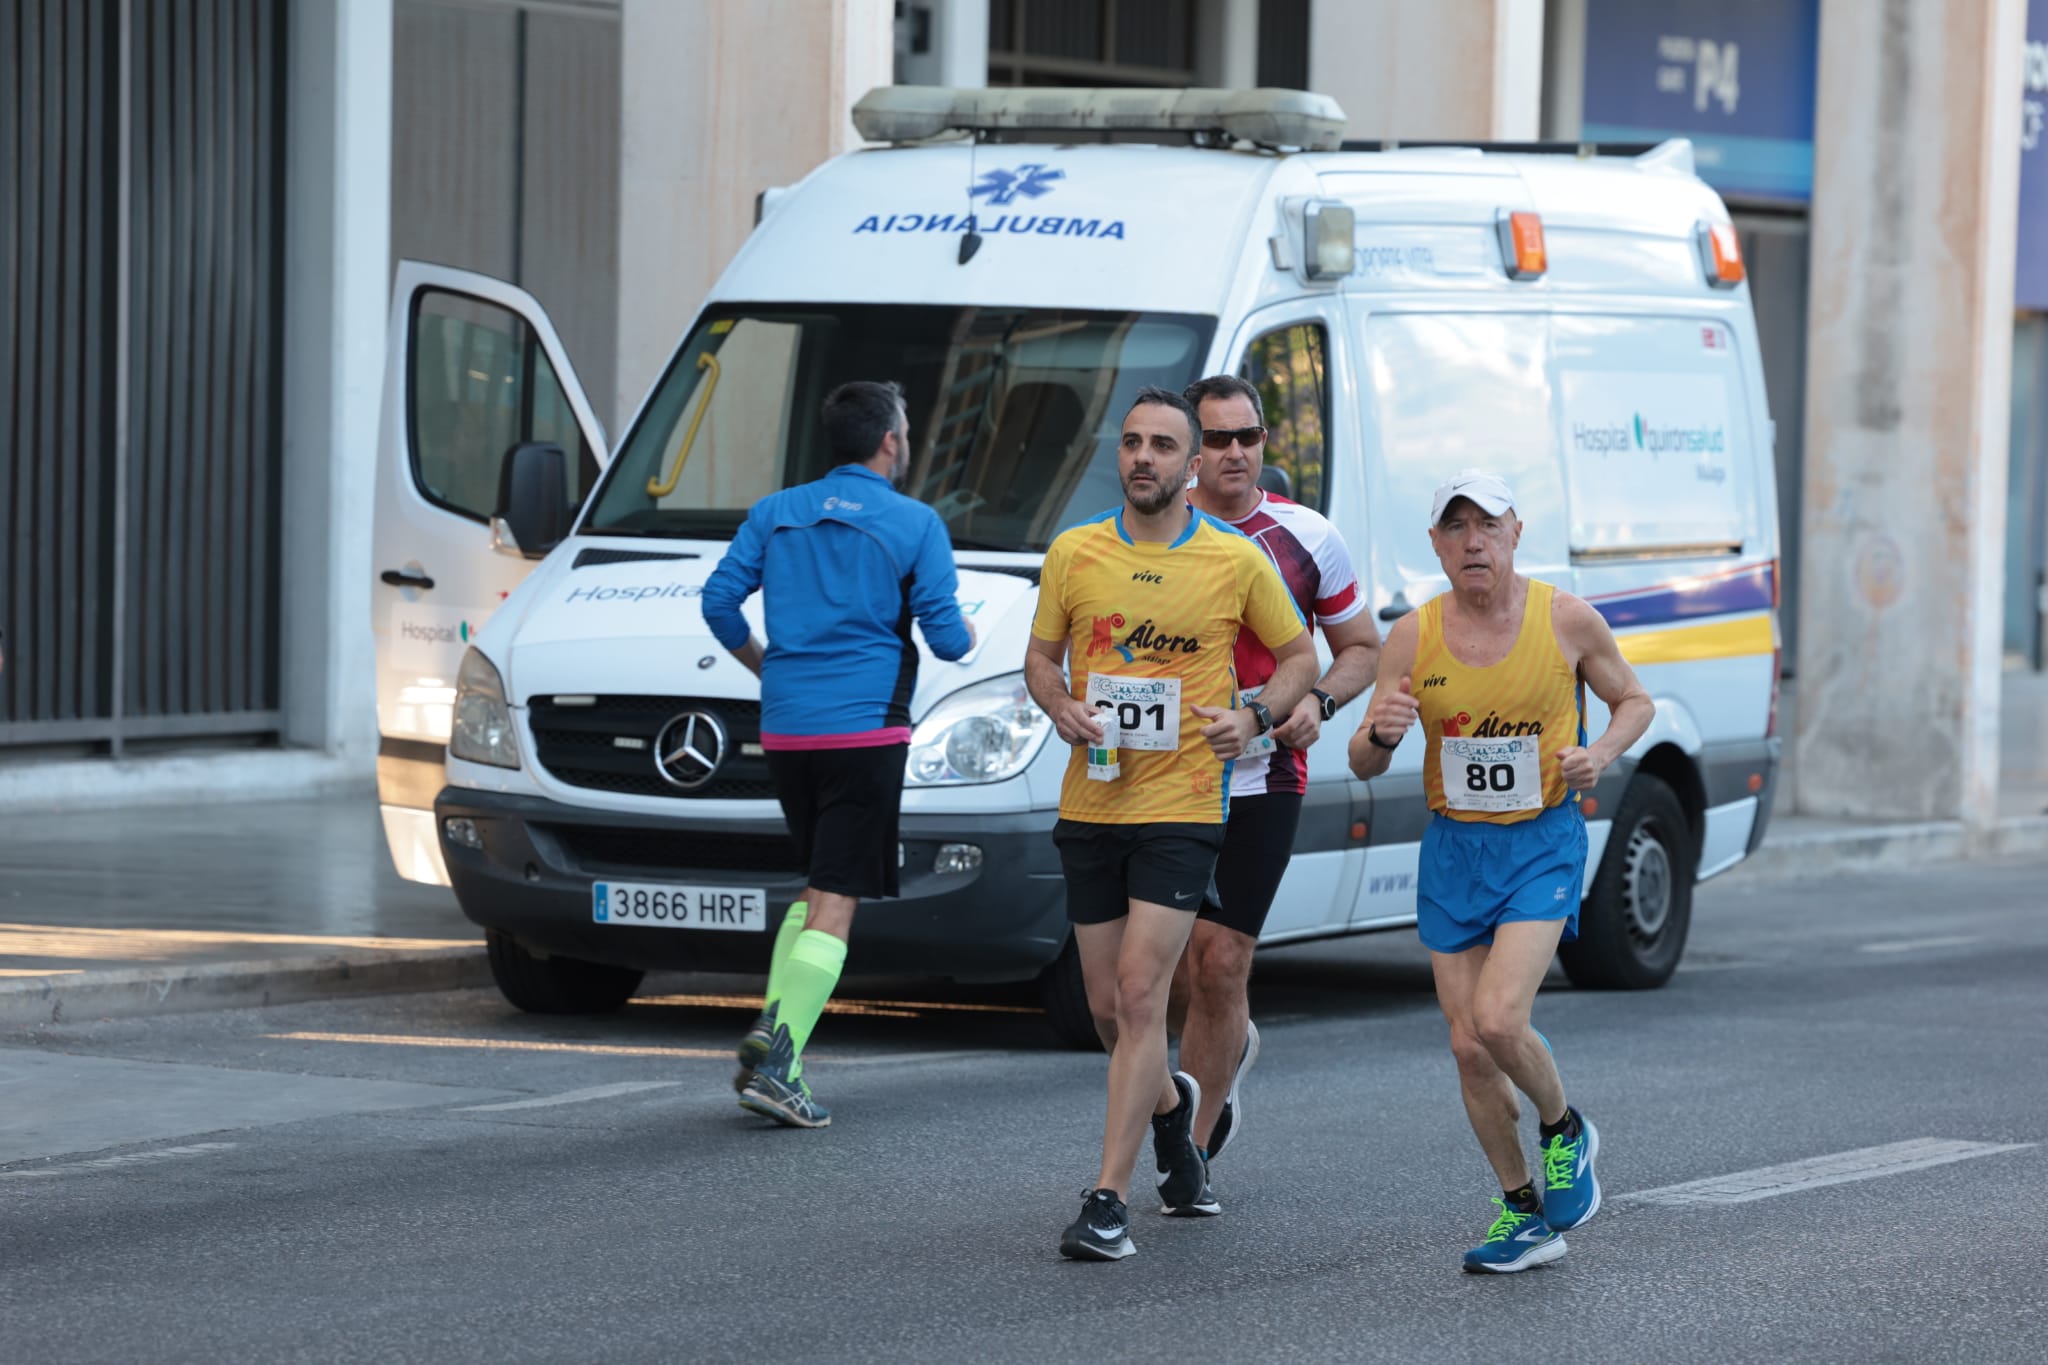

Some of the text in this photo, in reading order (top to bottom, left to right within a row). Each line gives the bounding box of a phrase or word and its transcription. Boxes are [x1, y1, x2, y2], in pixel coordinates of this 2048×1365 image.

[1574, 422, 1631, 458] Hospital
[566, 583, 703, 604] Hospita
[402, 620, 456, 643] Hospital
[1125, 619, 1200, 654] Álora
[1473, 711, 1543, 738] Álora
[1466, 764, 1515, 792] 80
[614, 888, 688, 921] 3866
[699, 893, 756, 924] HRF
